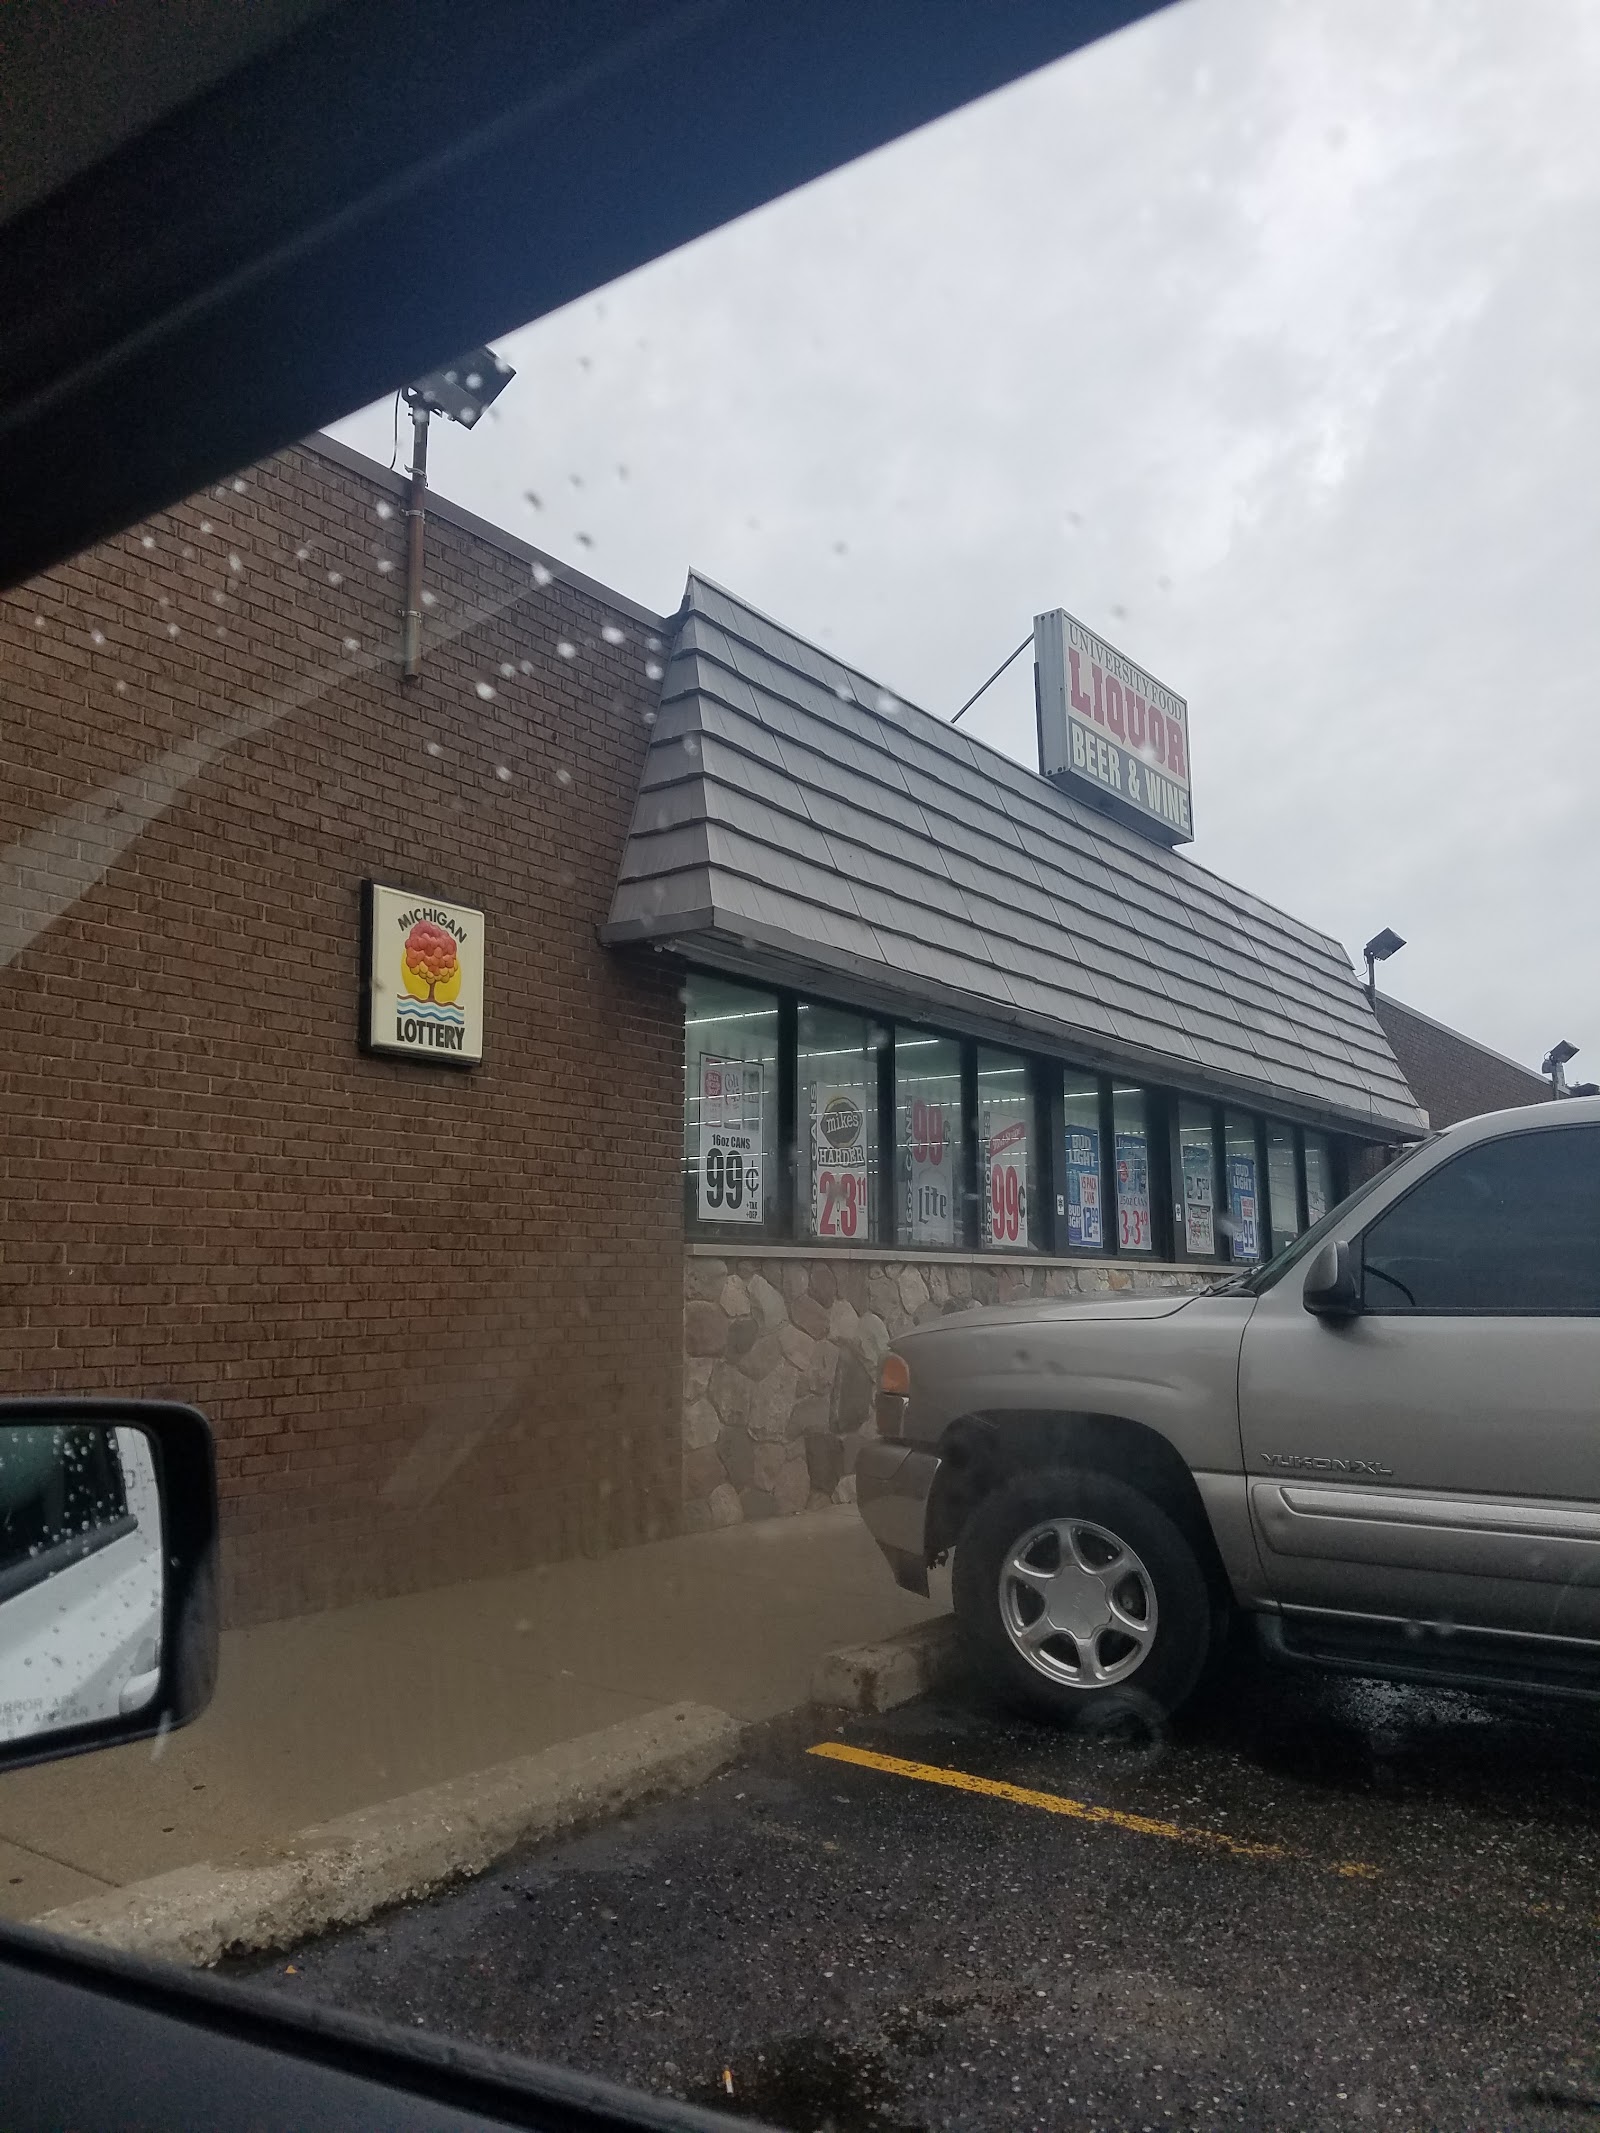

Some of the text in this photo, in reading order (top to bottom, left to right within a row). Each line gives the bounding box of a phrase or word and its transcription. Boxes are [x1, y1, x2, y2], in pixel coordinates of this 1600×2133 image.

[1068, 622, 1182, 721] UNIVERSITY FOOD
[1068, 646, 1186, 779] LIQUOR
[1072, 722, 1191, 830] BEER & WINE
[397, 908, 467, 944] MICHIGAN
[396, 1016, 465, 1051] LOTTERY
[712, 1133, 751, 1149] 16oz CANS
[1071, 1135, 1092, 1151] BUD
[819, 1147, 865, 1164] HARDER
[1069, 1149, 1096, 1168] LIGHT
[1235, 1163, 1249, 1177] BUD
[1233, 1175, 1252, 1191] LIGHT
[917, 1184, 947, 1224] Lite
[1068, 1204, 1081, 1217] BUD
[1260, 1452, 1394, 1476] YUKON XL
